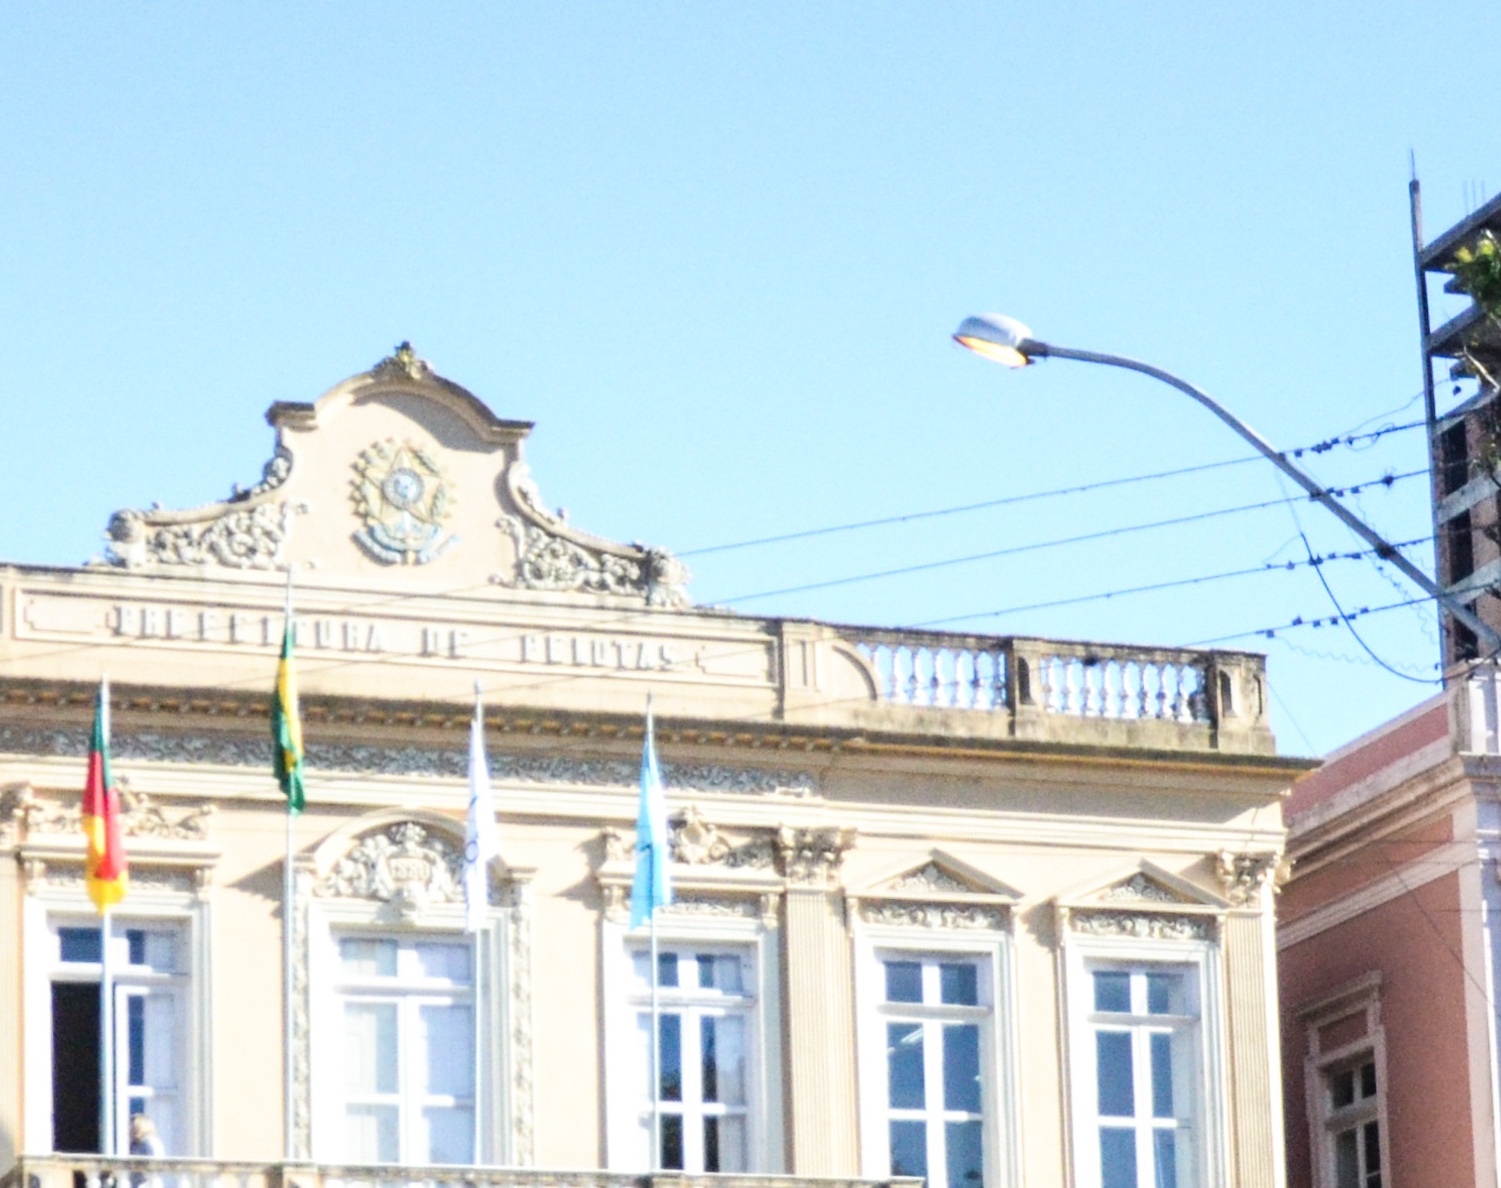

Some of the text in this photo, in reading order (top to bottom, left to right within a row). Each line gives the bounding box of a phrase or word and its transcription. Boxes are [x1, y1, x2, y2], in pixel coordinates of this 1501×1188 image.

[113, 604, 678, 673] PREFEITURA DE PELOTAS
